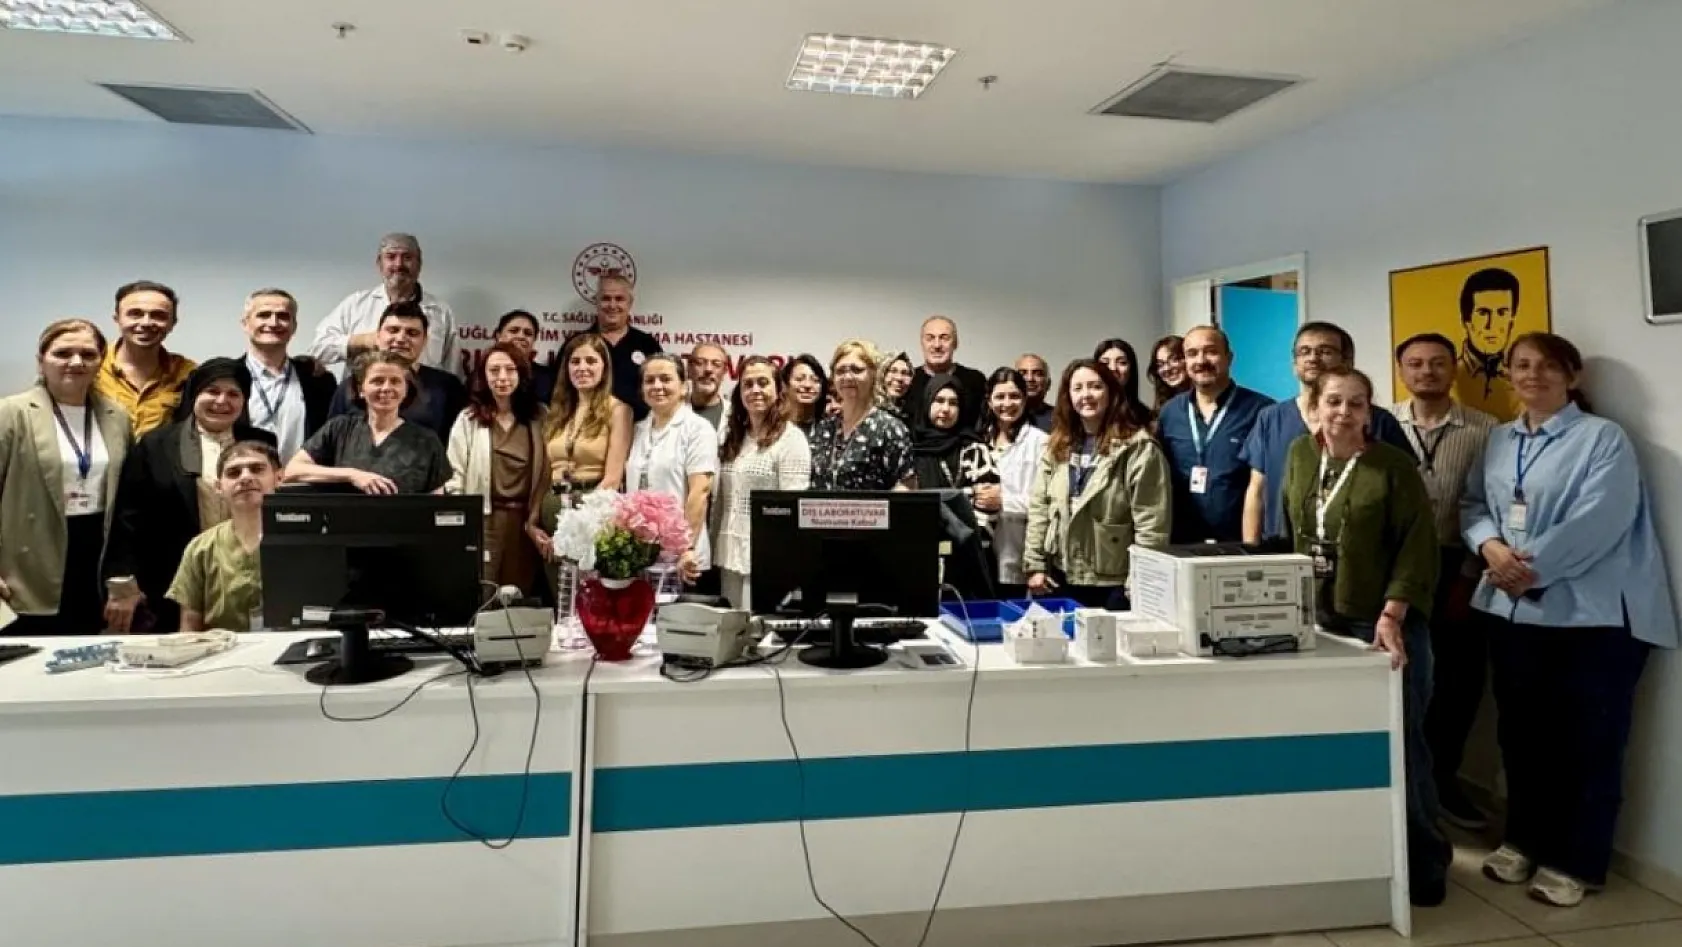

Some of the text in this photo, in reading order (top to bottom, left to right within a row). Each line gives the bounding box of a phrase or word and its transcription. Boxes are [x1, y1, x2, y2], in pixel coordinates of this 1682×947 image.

[542, 311, 663, 326] T.C. SAĞLI ANLIĞI
[674, 332, 753, 346] HASTANESİ
